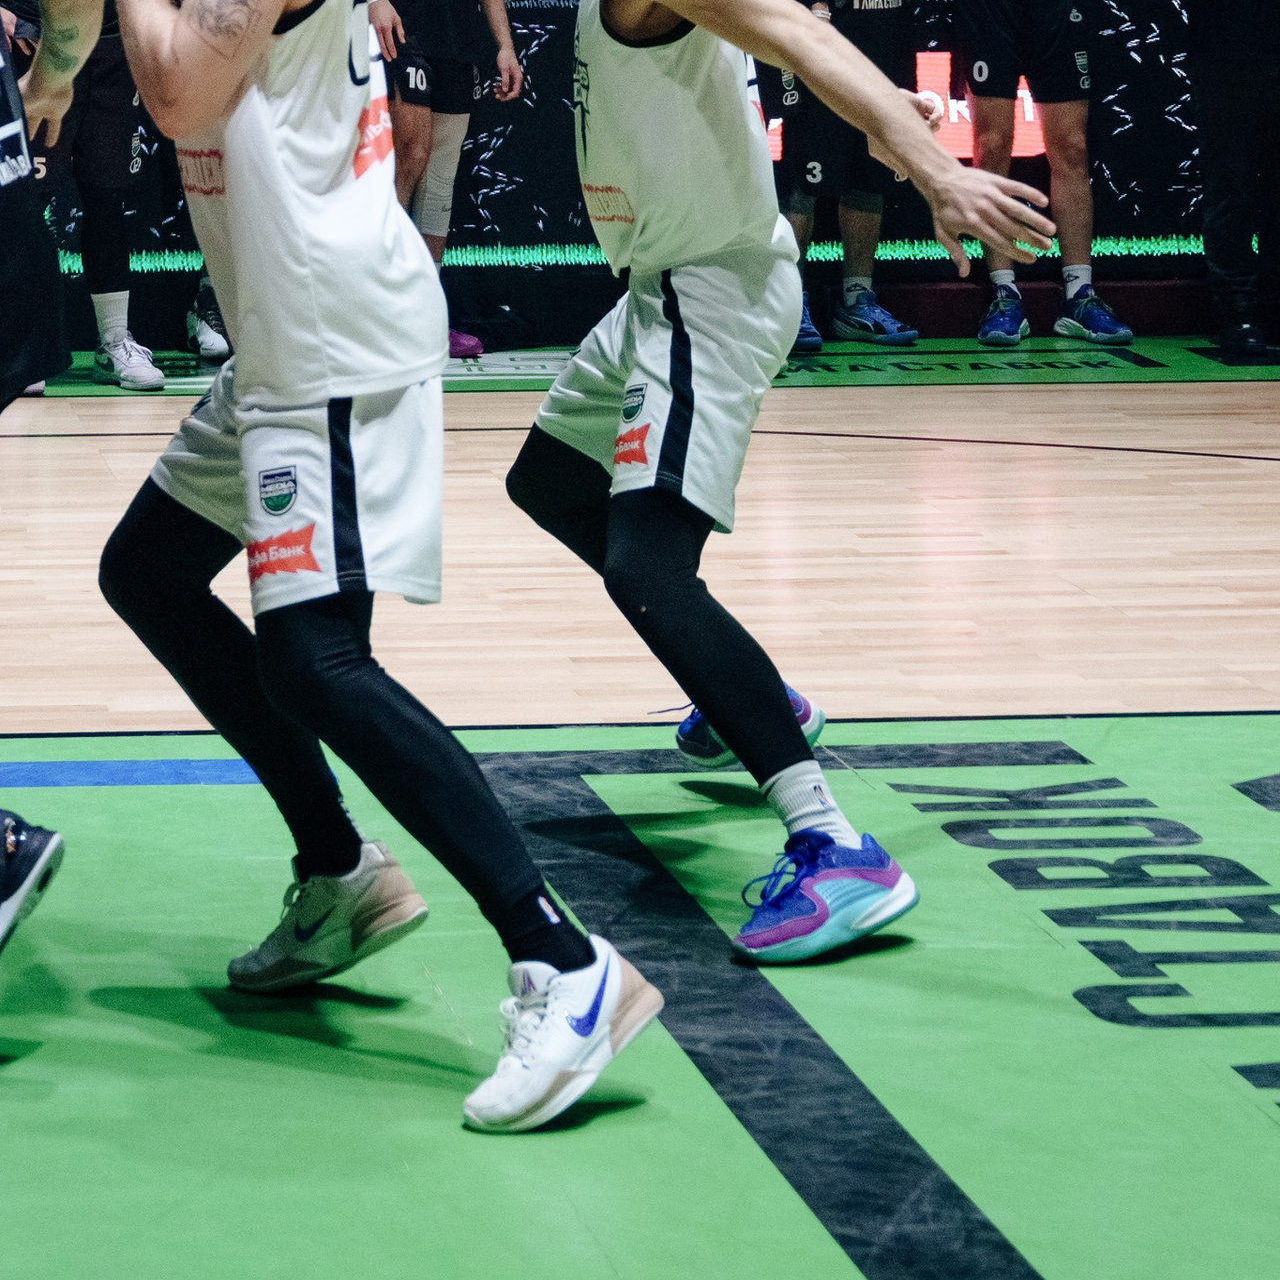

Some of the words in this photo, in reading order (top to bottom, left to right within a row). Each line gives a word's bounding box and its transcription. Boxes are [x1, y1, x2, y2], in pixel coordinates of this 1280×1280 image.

[406, 67, 427, 91] 10
[973, 61, 988, 82] 0
[33, 157, 47, 179] 5
[806, 162, 823, 184] 3
[269, 544, 305, 560] Банк
